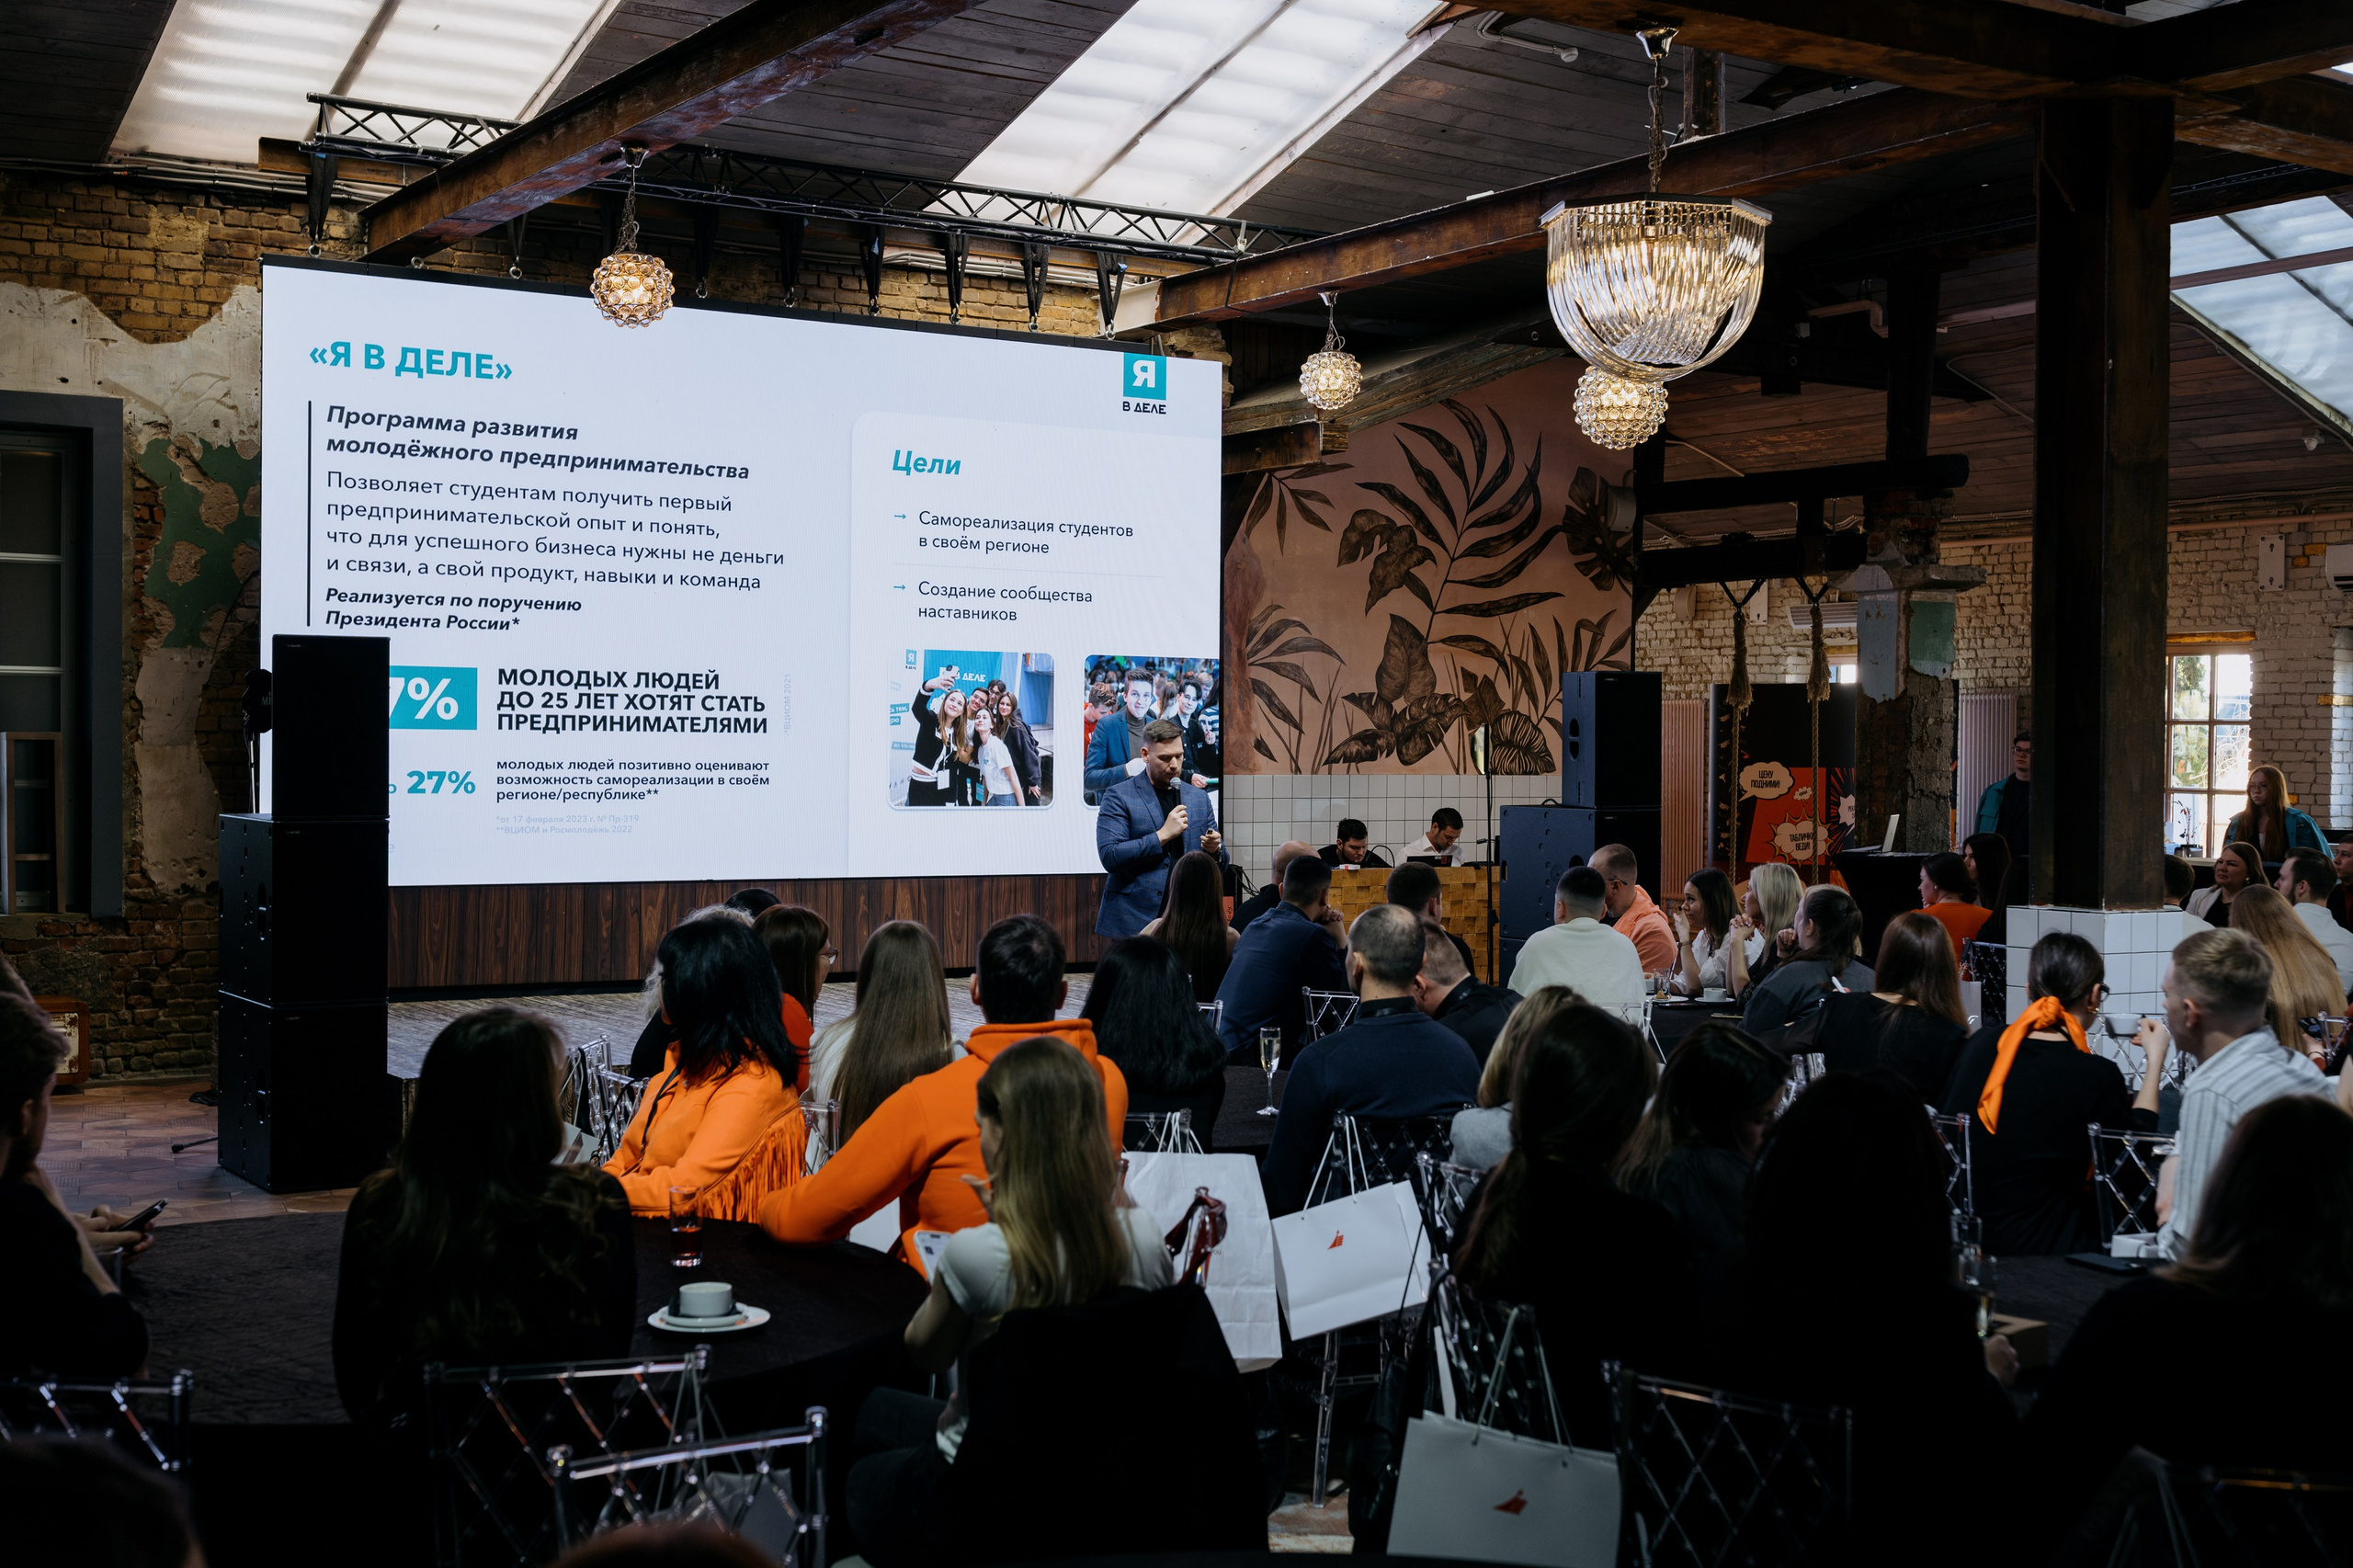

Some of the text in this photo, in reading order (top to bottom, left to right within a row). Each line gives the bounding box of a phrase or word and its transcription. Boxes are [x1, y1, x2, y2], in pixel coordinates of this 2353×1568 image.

[310, 341, 512, 380] «Я В ДЕЛЕ»
[1132, 359, 1156, 389] Я
[1123, 402, 1166, 415] В ДЕЛЕ
[327, 405, 578, 440] Программа развития
[327, 439, 749, 479] молодёжного предпринимательства
[892, 449, 961, 476] Цели
[328, 472, 731, 514] Позволяет студентам получить первый
[328, 504, 719, 539] предпринимательской опыт и понять,
[919, 511, 1132, 538] Самореализация студентов
[327, 531, 783, 565] что для успешного бизнеса нужны не деньги
[920, 536, 1049, 554] в своём регионе
[327, 559, 760, 591] и связи, а свой продукт, навыки и команда
[326, 588, 581, 613] Реализуется по поручению
[919, 581, 1092, 603] Создание сообщества
[326, 610, 440, 629] Президента
[919, 608, 1017, 620] наставников
[498, 668, 719, 692] МОЛОДЫХ ЛЮДЕЙ
[962, 672, 986, 682] ДЕЛЕ
[497, 691, 765, 711] ДО 25 ЛЕТ ХОТЯТ СТАТЬ
[498, 713, 767, 734] ПРЕДПРИНИМАТЕЛЯМИ
[497, 759, 769, 772] молодых людей позитивно оценивают
[1758, 770, 1774, 779] ЦЕНУ
[407, 770, 476, 794] 27%
[597, 777, 714, 787] самореализации
[729, 774, 768, 785] своём
[1750, 779, 1780, 789] ПОДНИМИ!
[513, 815, 523, 824] 17
[526, 815, 563, 824] февраля
[566, 814, 587, 824] 2023
[609, 814, 640, 824] Пр-319
[550, 825, 609, 835] Росмолодёжь
[611, 824, 633, 834] 2022
[1795, 842, 1811, 851] ВЕДИ!
